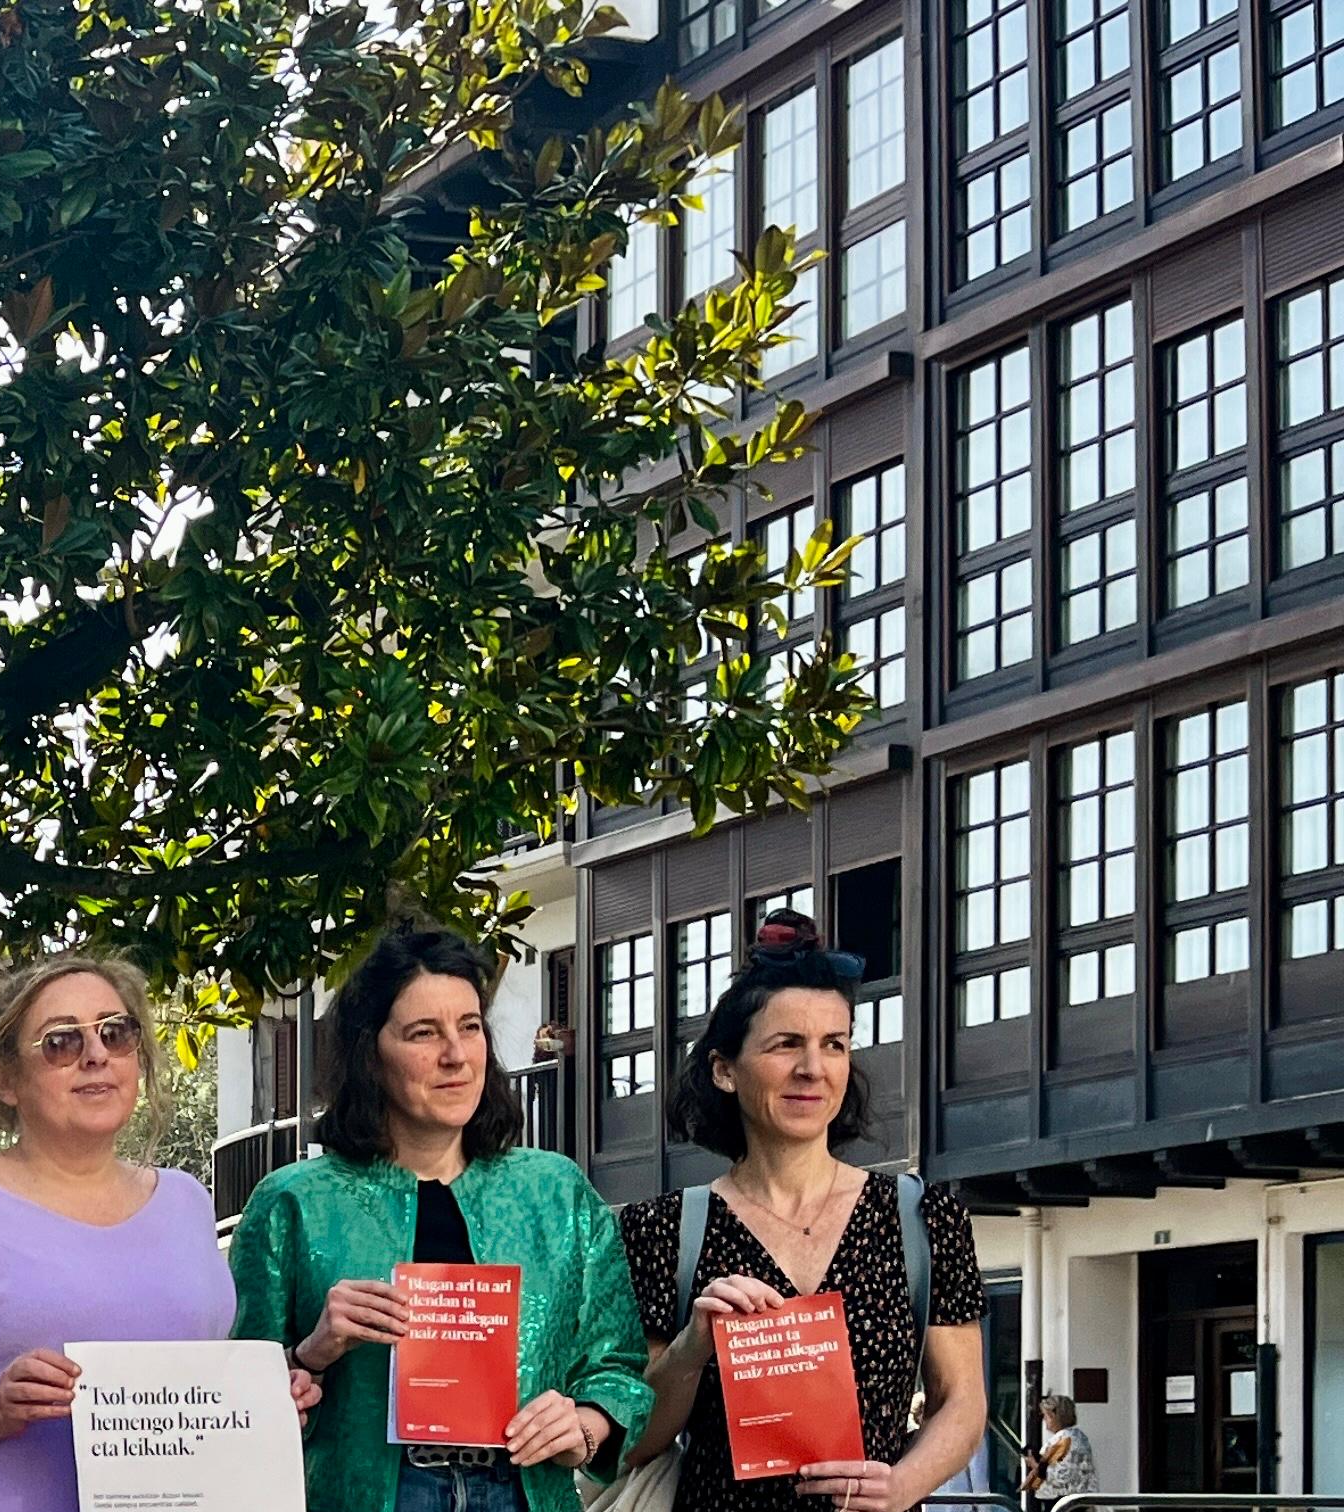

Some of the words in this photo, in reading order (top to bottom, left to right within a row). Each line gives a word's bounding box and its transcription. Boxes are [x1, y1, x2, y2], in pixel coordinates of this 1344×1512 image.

[409, 1294, 459, 1307] dendan
[463, 1297, 475, 1308] ta
[184, 1386, 221, 1404] dire
[91, 1413, 173, 1434] hemengo
[179, 1411, 250, 1429] barazki
[92, 1441, 118, 1456] eta
